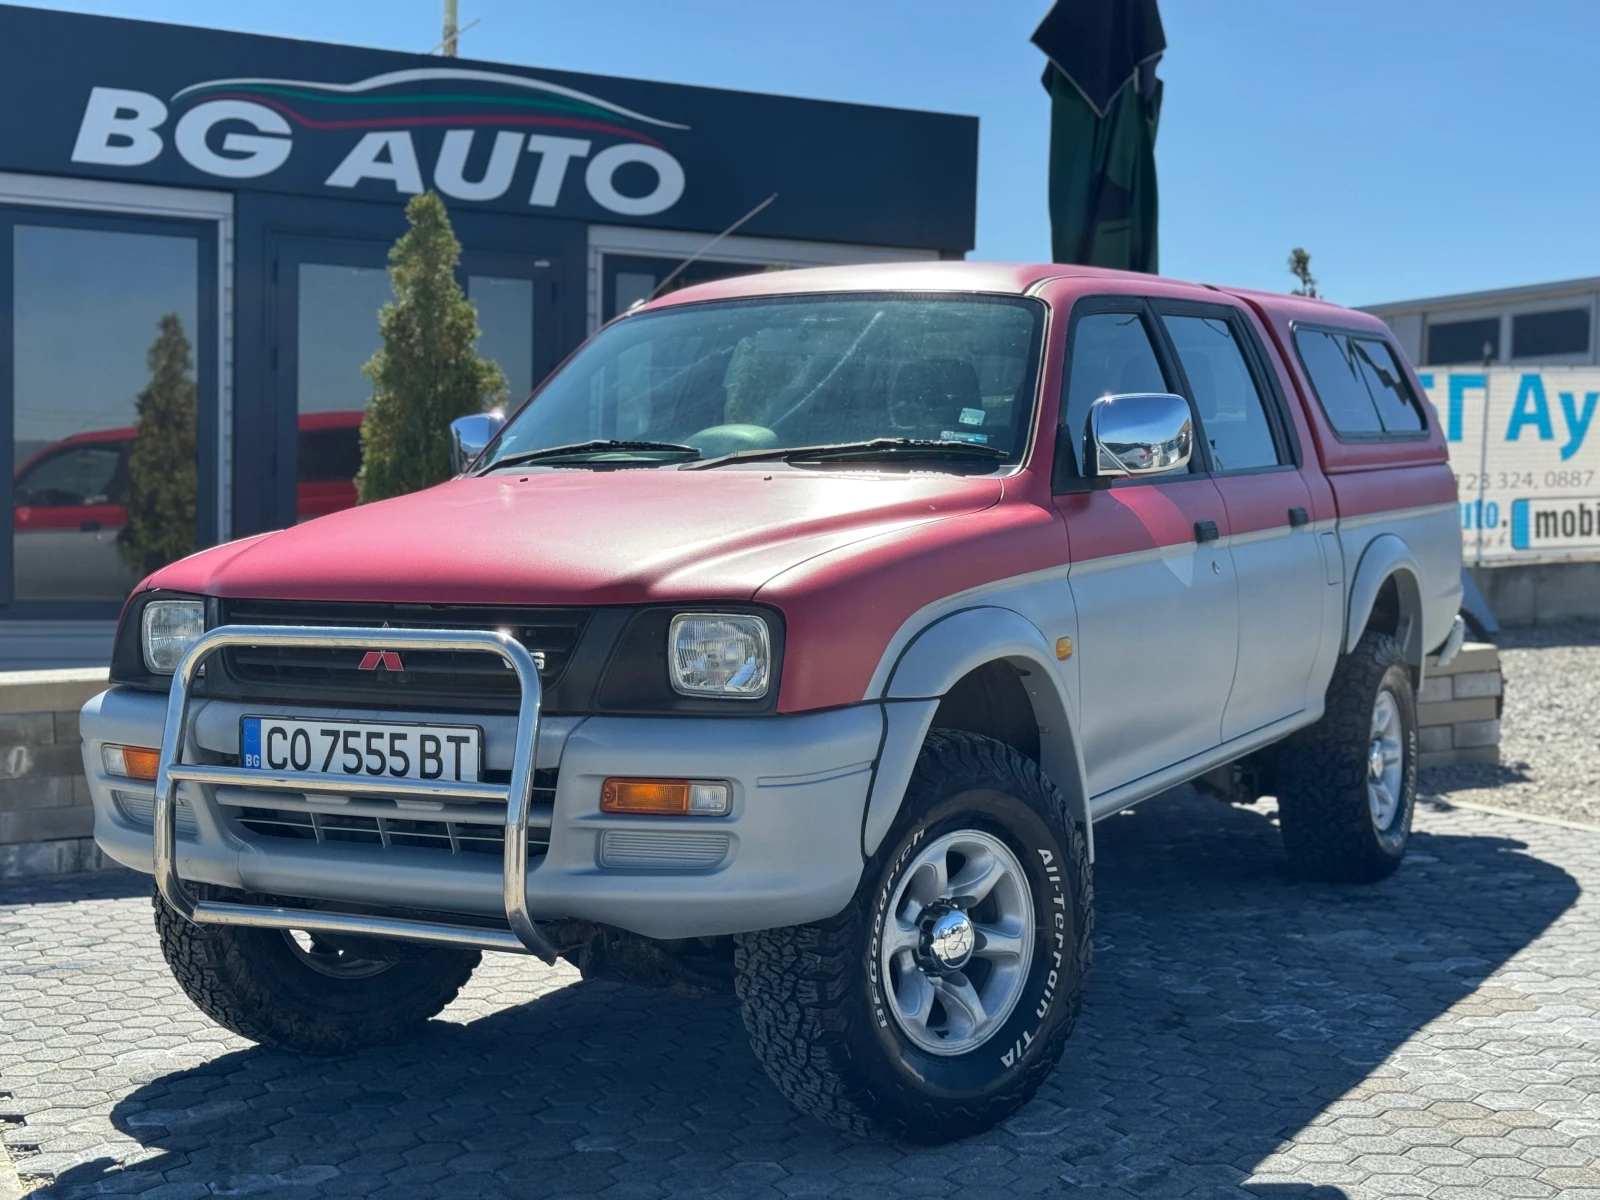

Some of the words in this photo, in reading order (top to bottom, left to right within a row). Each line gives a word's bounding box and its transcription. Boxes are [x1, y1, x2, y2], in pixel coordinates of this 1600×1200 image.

[71, 86, 293, 178] BG
[324, 129, 686, 216] AUTO
[1497, 471, 1539, 491] 324,
[1544, 469, 1595, 488] 0887
[245, 754, 260, 768] BG
[868, 828, 926, 1029] BFGoodrich
[1035, 848, 1067, 1019] All-Terrain
[999, 1030, 1036, 1069] T/A
